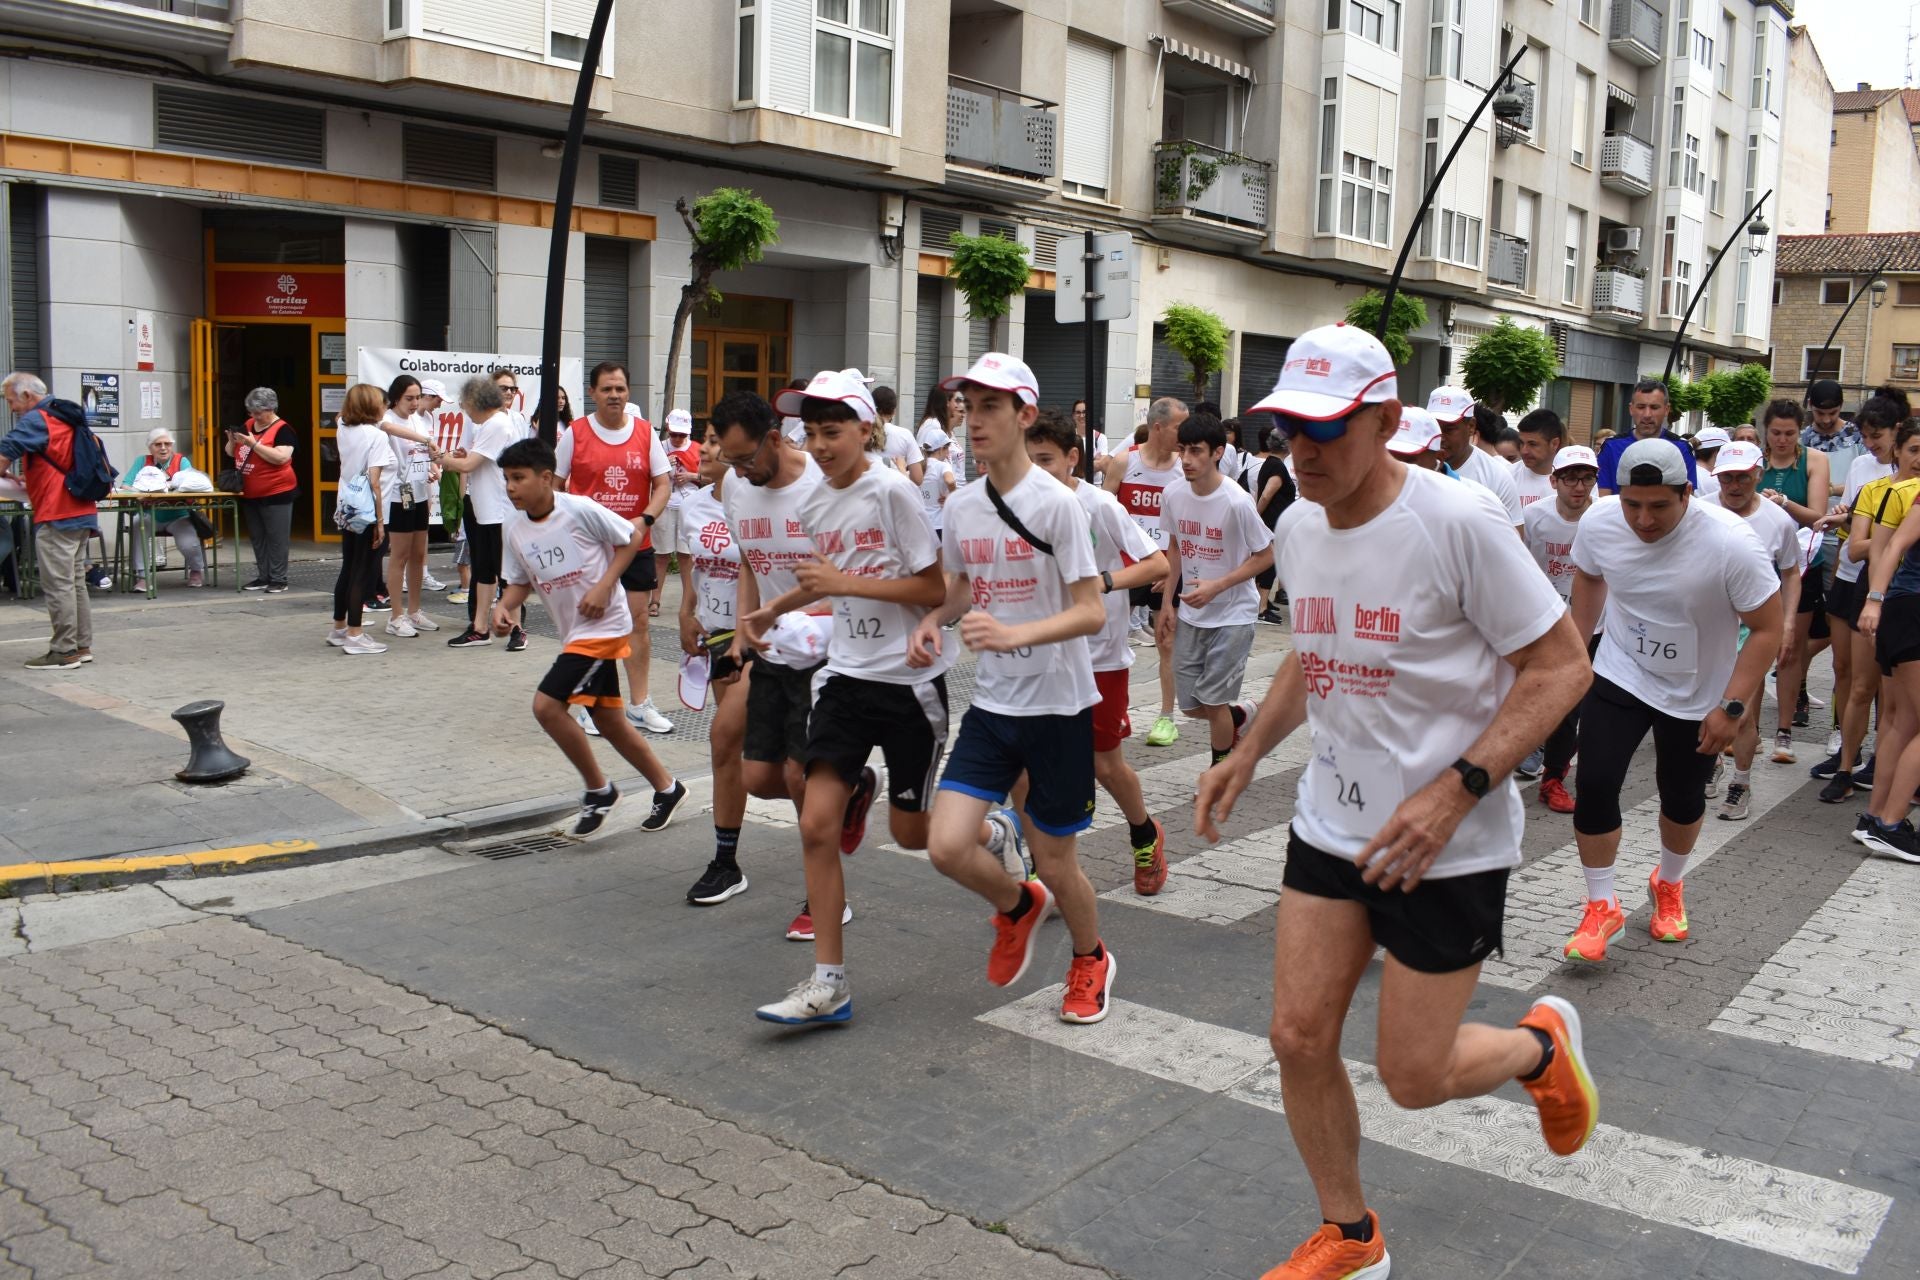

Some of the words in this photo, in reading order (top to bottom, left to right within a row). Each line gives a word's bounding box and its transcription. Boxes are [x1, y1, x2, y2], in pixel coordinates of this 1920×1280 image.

[400, 358, 484, 374] Colaborador
[593, 492, 639, 501] Cáritas
[1131, 490, 1162, 508] 360
[855, 528, 883, 546] berlin
[537, 546, 565, 570] 179
[705, 594, 733, 616] 121
[846, 617, 885, 639] 142
[1355, 603, 1400, 633] berlin
[1636, 636, 1677, 660] 176
[1335, 774, 1366, 812] 24
